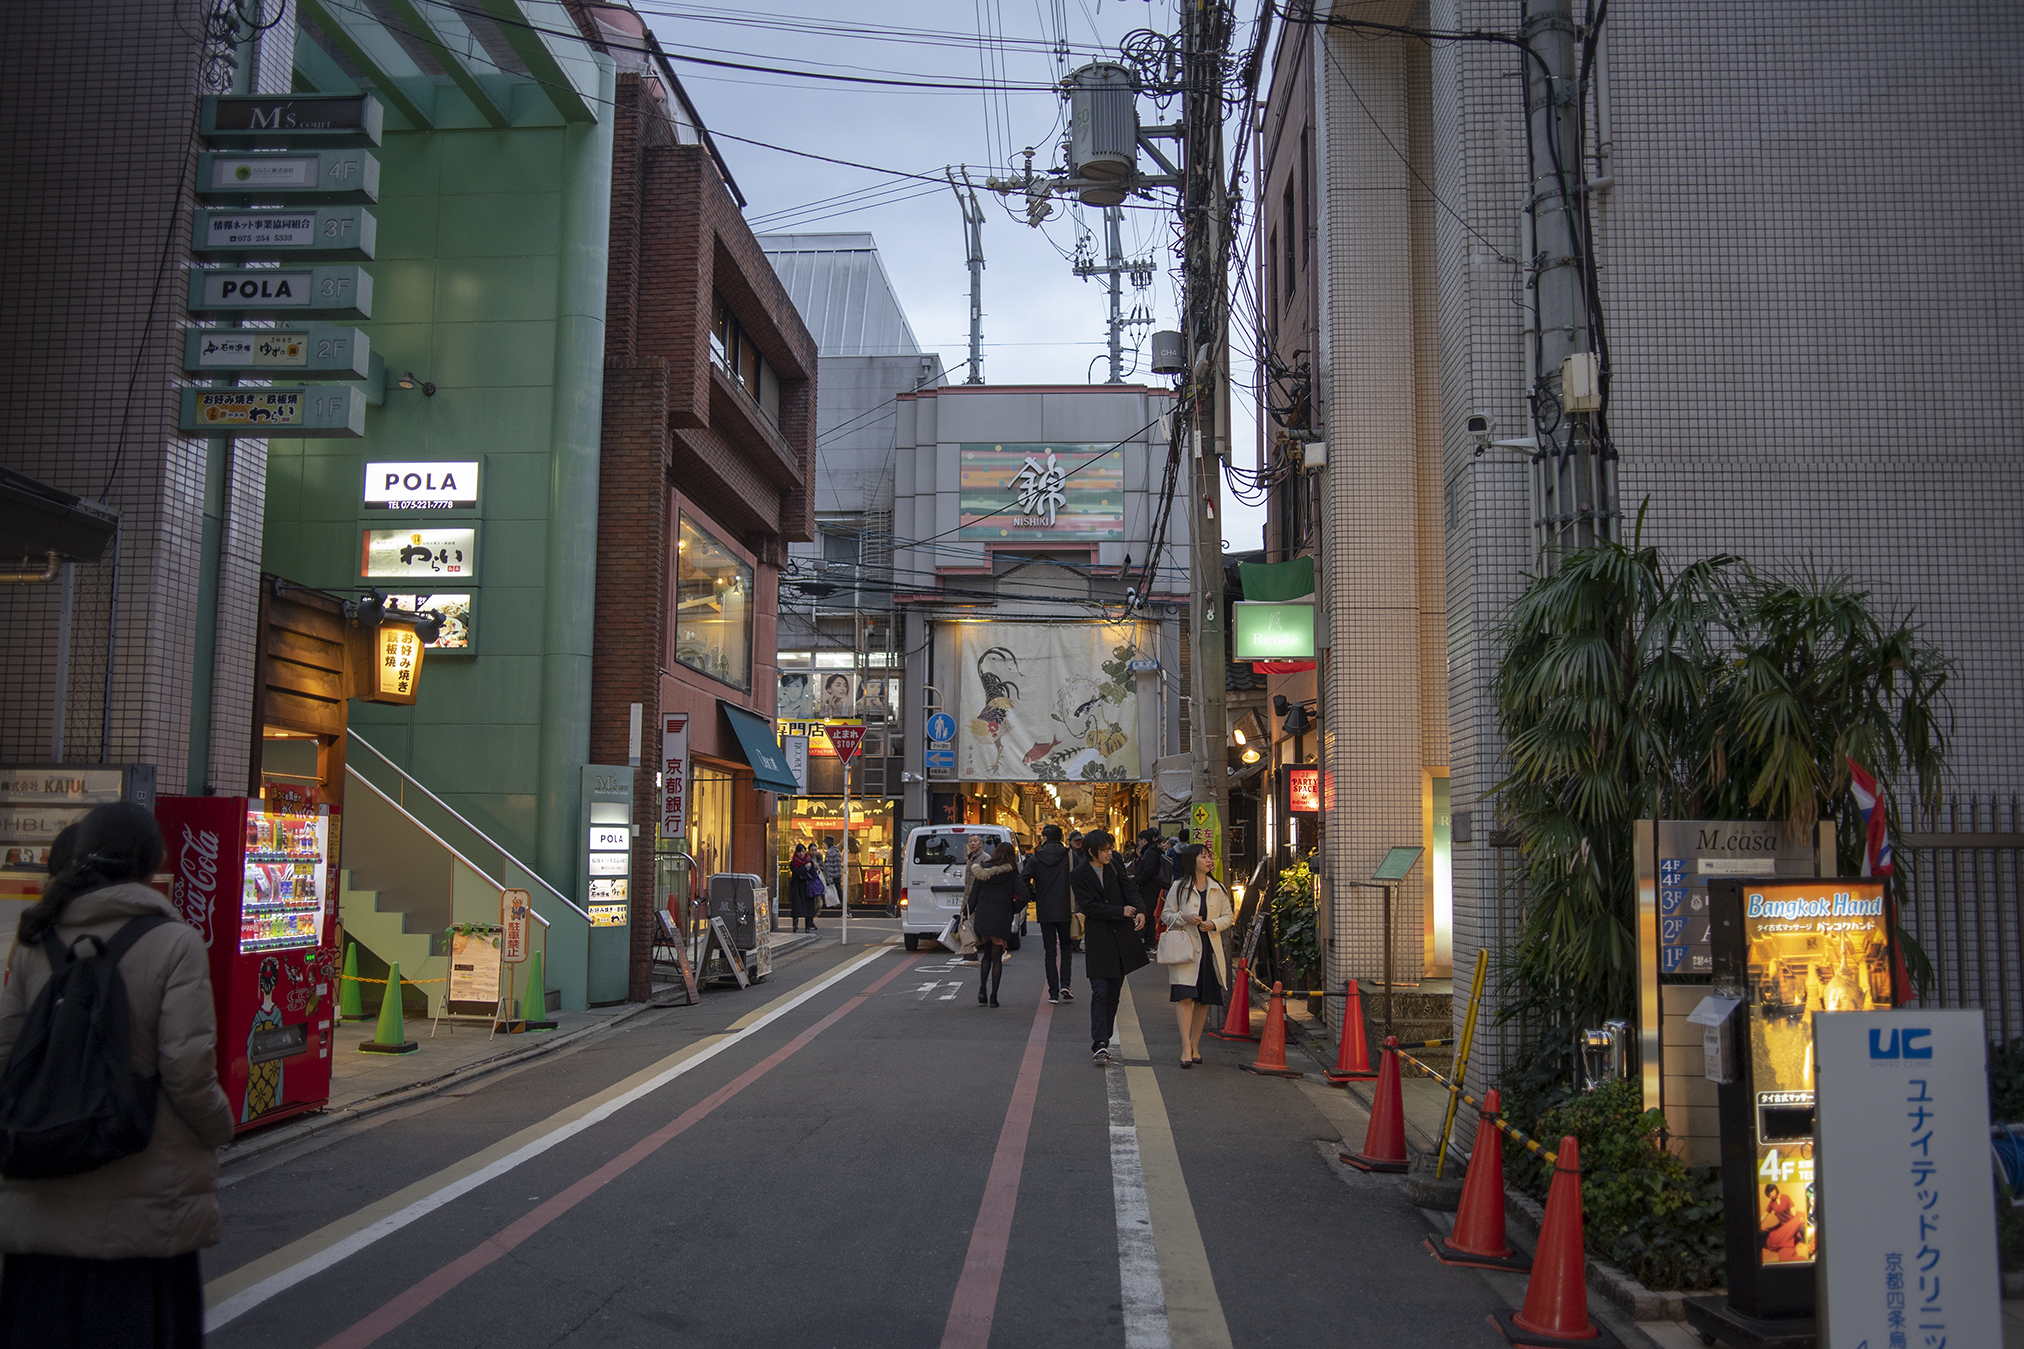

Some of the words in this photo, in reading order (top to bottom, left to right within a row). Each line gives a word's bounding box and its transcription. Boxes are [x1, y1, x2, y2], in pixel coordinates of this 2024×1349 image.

[328, 160, 358, 179] 4F
[213, 219, 310, 230] 情報ネット事業協同組合
[324, 218, 354, 237] 3F
[222, 280, 292, 298] POLA
[321, 278, 350, 297] 3F
[317, 340, 347, 358] 2F
[203, 394, 298, 405] お好み焼き・鉄板焼
[317, 398, 343, 416] 1F
[249, 407, 294, 423] わらい
[385, 473, 457, 491] POLA
[1007, 453, 1067, 527] 錦
[388, 501, 399, 509] TEL
[1013, 517, 1049, 527] NISHIKI
[400, 544, 463, 572] わらい
[1253, 632, 1299, 645] Renée
[385, 631, 398, 667] 鉄板焼
[398, 633, 413, 692] お好み焼き
[832, 729, 859, 739] 止まれ
[837, 740, 856, 748] STOP
[44, 780, 88, 793] KAIUL
[665, 758, 682, 832] 京都銀行
[1696, 830, 1777, 851] M.casa
[1662, 861, 1681, 872] 4F
[181, 822, 219, 936] oca-Cola
[1662, 874, 1681, 885] 4F
[1663, 891, 1683, 910] 3F
[1748, 894, 1831, 920] Bangkok
[1832, 893, 1883, 916] Hand
[1664, 919, 1683, 938] 2F
[1757, 924, 1812, 932] タイ古式マッサージ
[1816, 921, 1876, 931] バンコクハンド
[507, 922, 519, 957] 駐車禁止
[1666, 949, 1683, 967] 1F
[1869, 1029, 1932, 1059] UC
[1759, 1149, 1795, 1182] 4F
